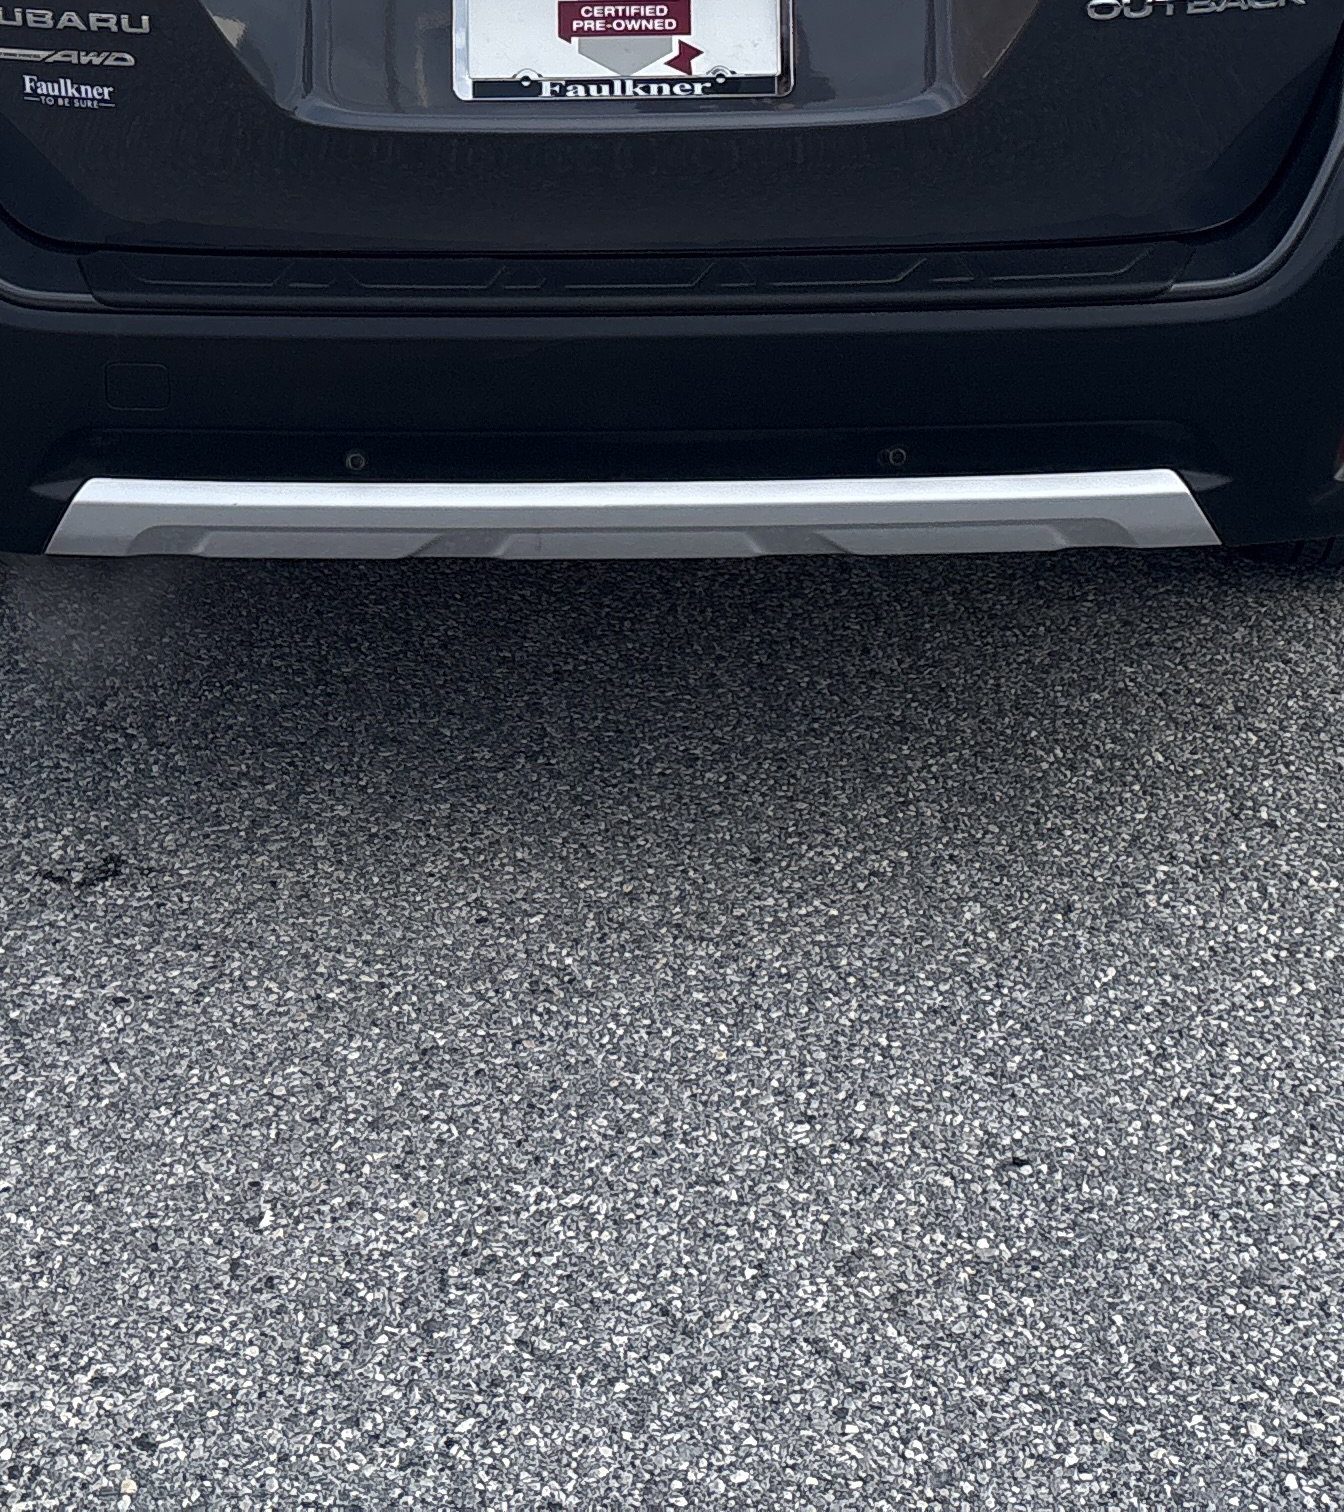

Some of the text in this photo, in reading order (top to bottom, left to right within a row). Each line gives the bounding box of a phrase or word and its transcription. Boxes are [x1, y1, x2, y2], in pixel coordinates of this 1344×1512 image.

[580, 5, 668, 17] CERTIFIED
[572, 19, 677, 31] PRE-OWNED
[44, 50, 135, 66] AWD
[22, 74, 114, 100] Faulkner
[540, 80, 712, 98] Faulkner
[40, 96, 99, 108] TO BE SURE
